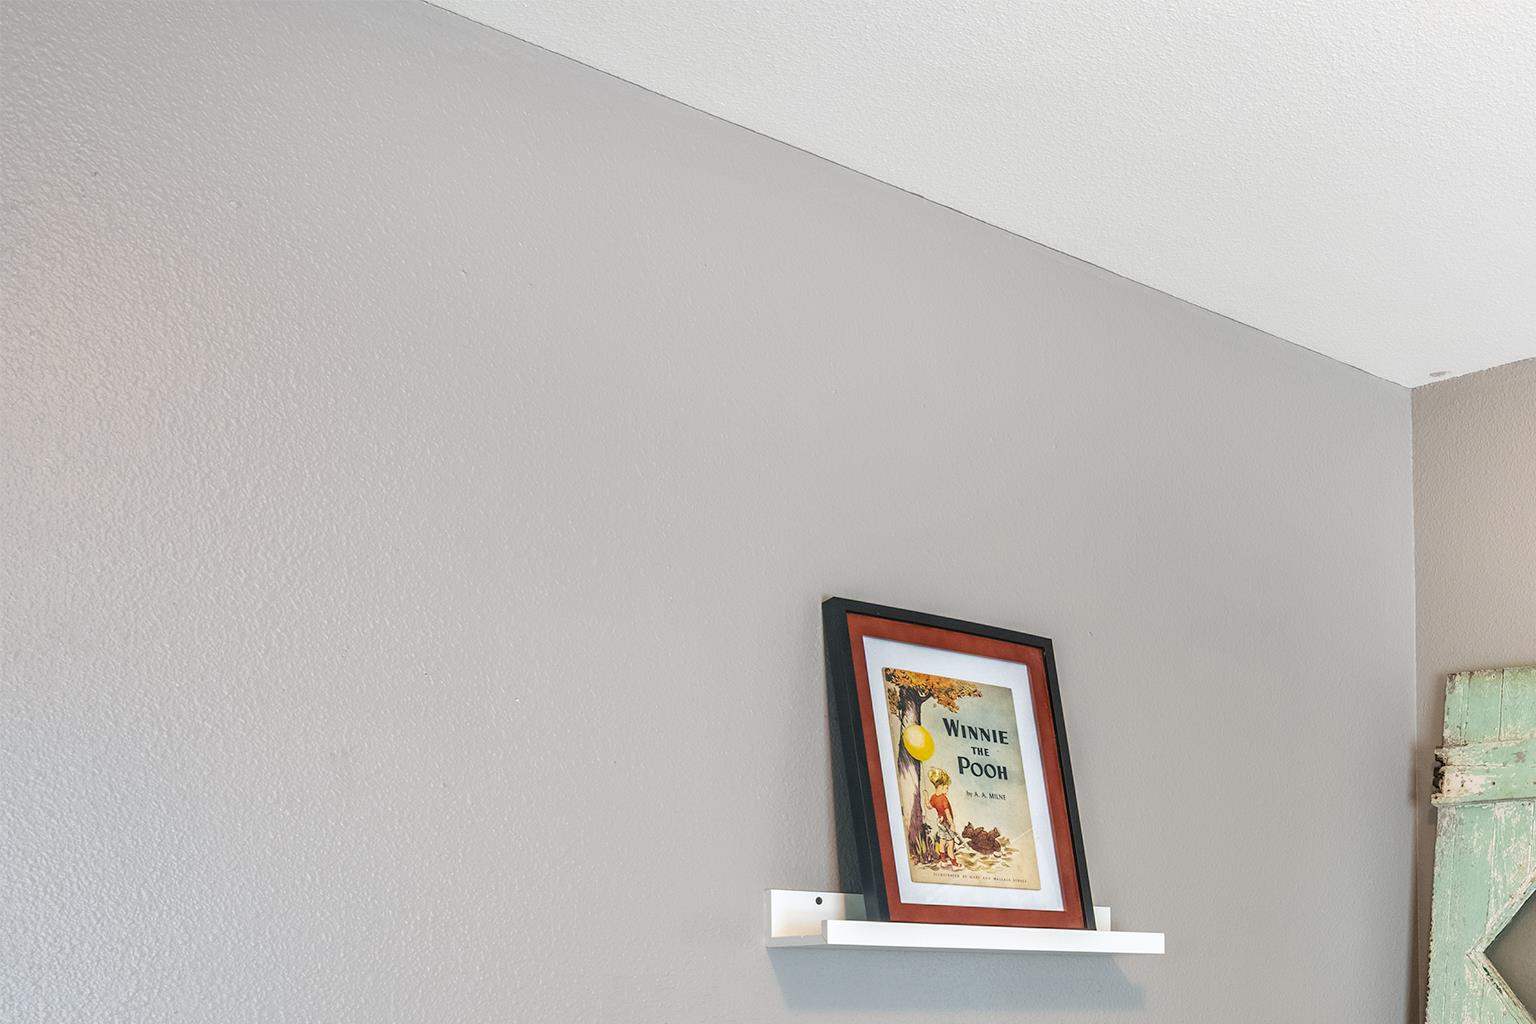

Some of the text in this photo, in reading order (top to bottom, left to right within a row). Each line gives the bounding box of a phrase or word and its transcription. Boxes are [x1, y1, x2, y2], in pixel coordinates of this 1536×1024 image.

[942, 717, 1009, 745] WINNIE
[971, 746, 990, 757] THE
[957, 756, 1008, 780] POOH
